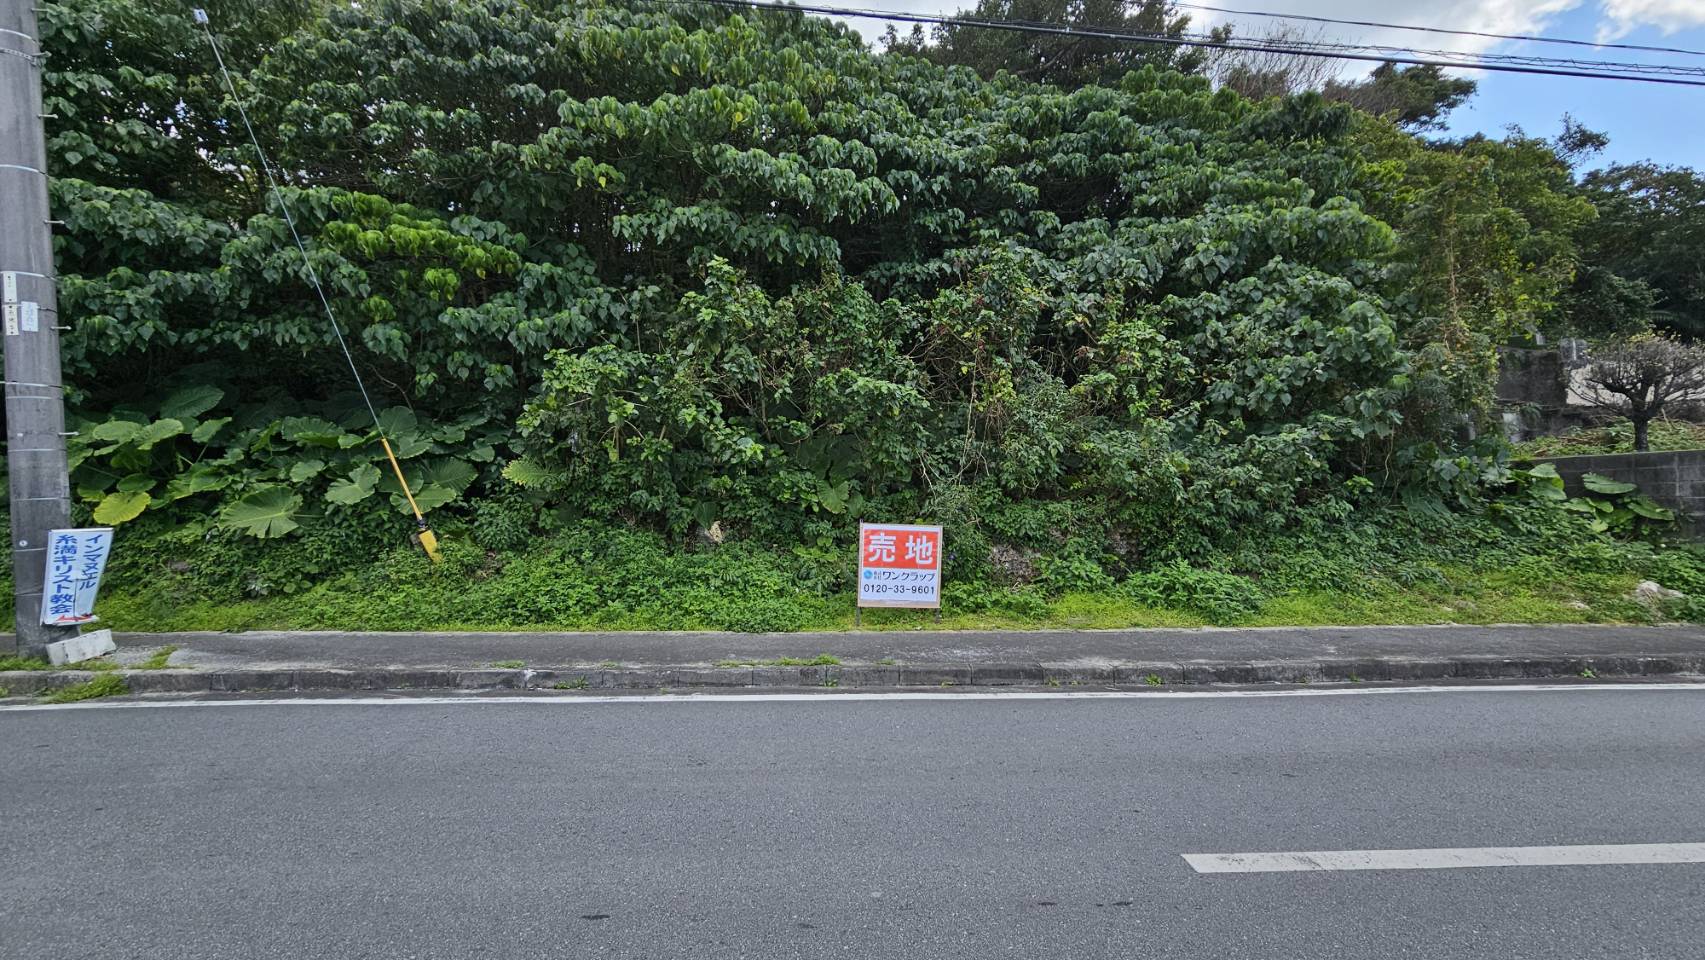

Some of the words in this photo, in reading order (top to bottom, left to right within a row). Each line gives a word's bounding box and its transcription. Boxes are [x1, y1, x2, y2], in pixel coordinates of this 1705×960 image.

[79, 534, 104, 590] インマヌエル
[868, 532, 933, 564] 売地
[50, 534, 78, 615] 糸満キリスト教会
[863, 584, 935, 594] 0120-33-9601
